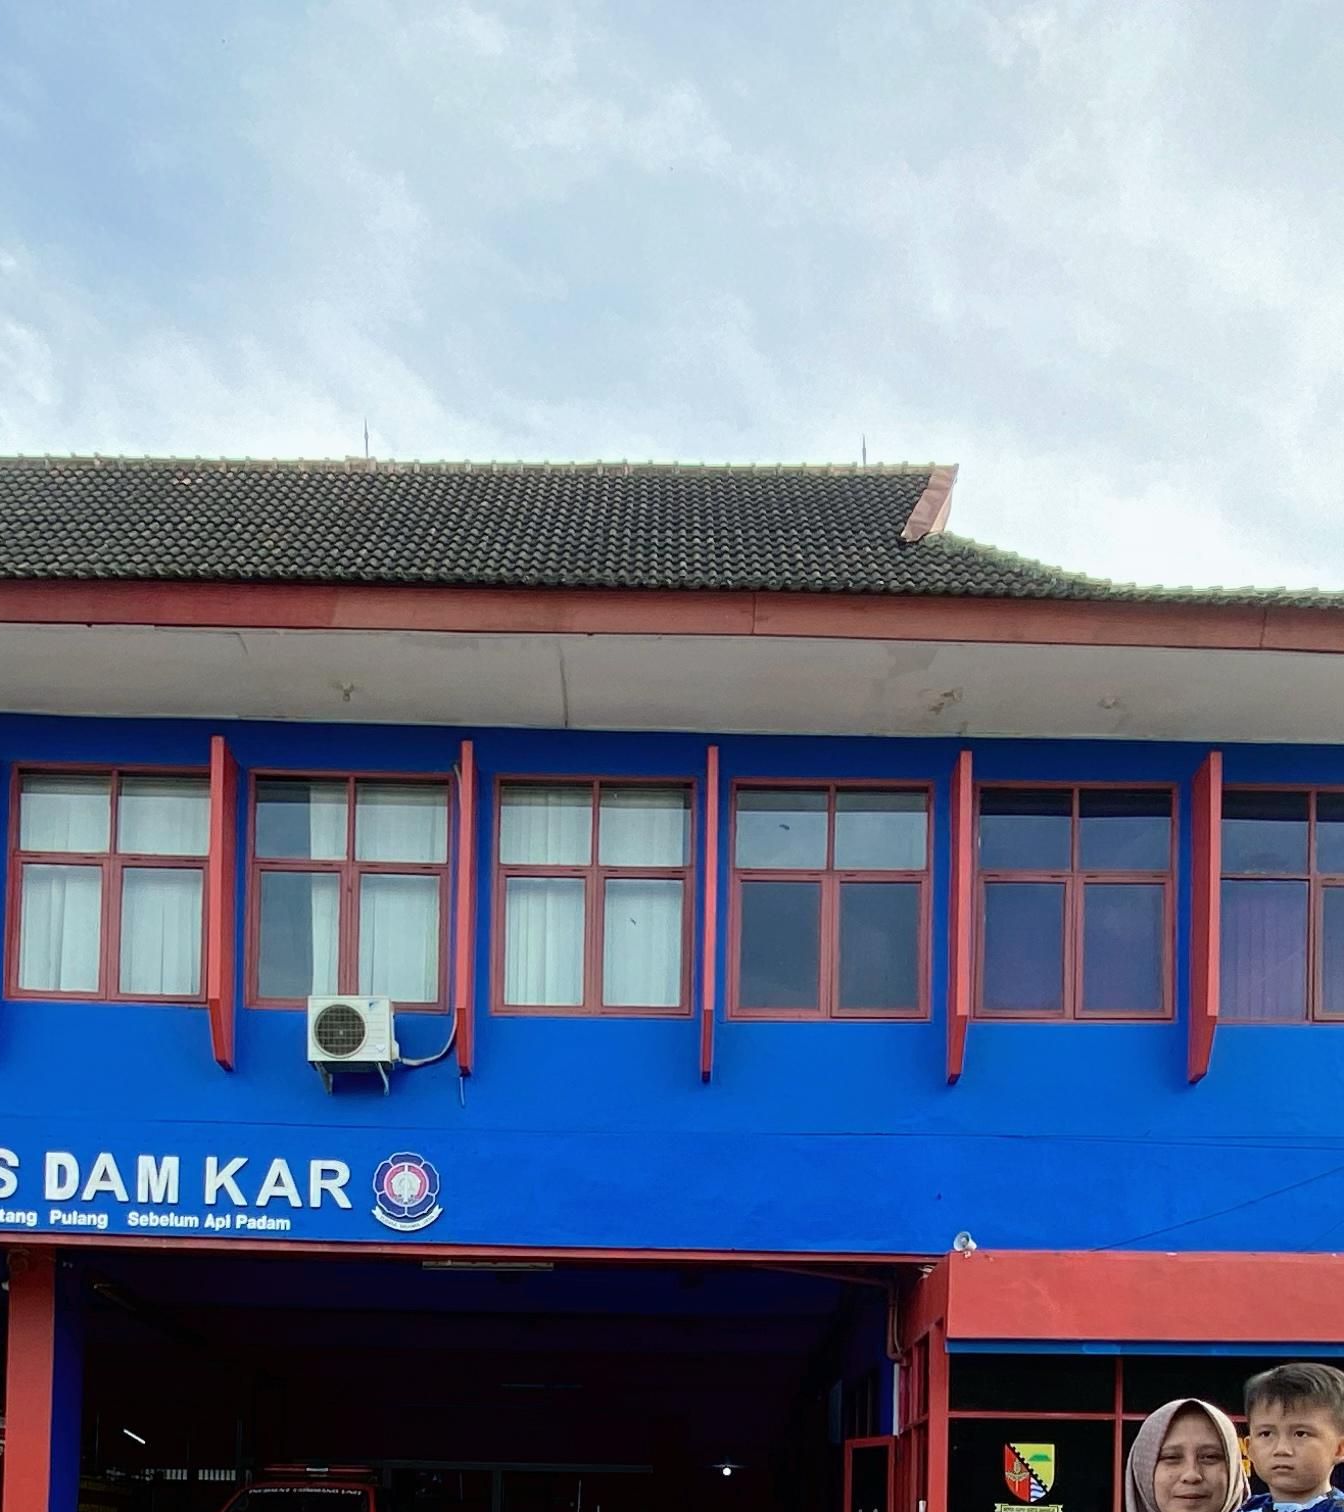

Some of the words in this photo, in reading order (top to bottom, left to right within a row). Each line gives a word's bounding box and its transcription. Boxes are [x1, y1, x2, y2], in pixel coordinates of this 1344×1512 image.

[44, 1151, 180, 1204] DAM
[204, 1157, 353, 1210] KAR
[50, 1210, 109, 1229] Pulang
[127, 1211, 199, 1229] Sebelum
[235, 1215, 292, 1231] Padam
